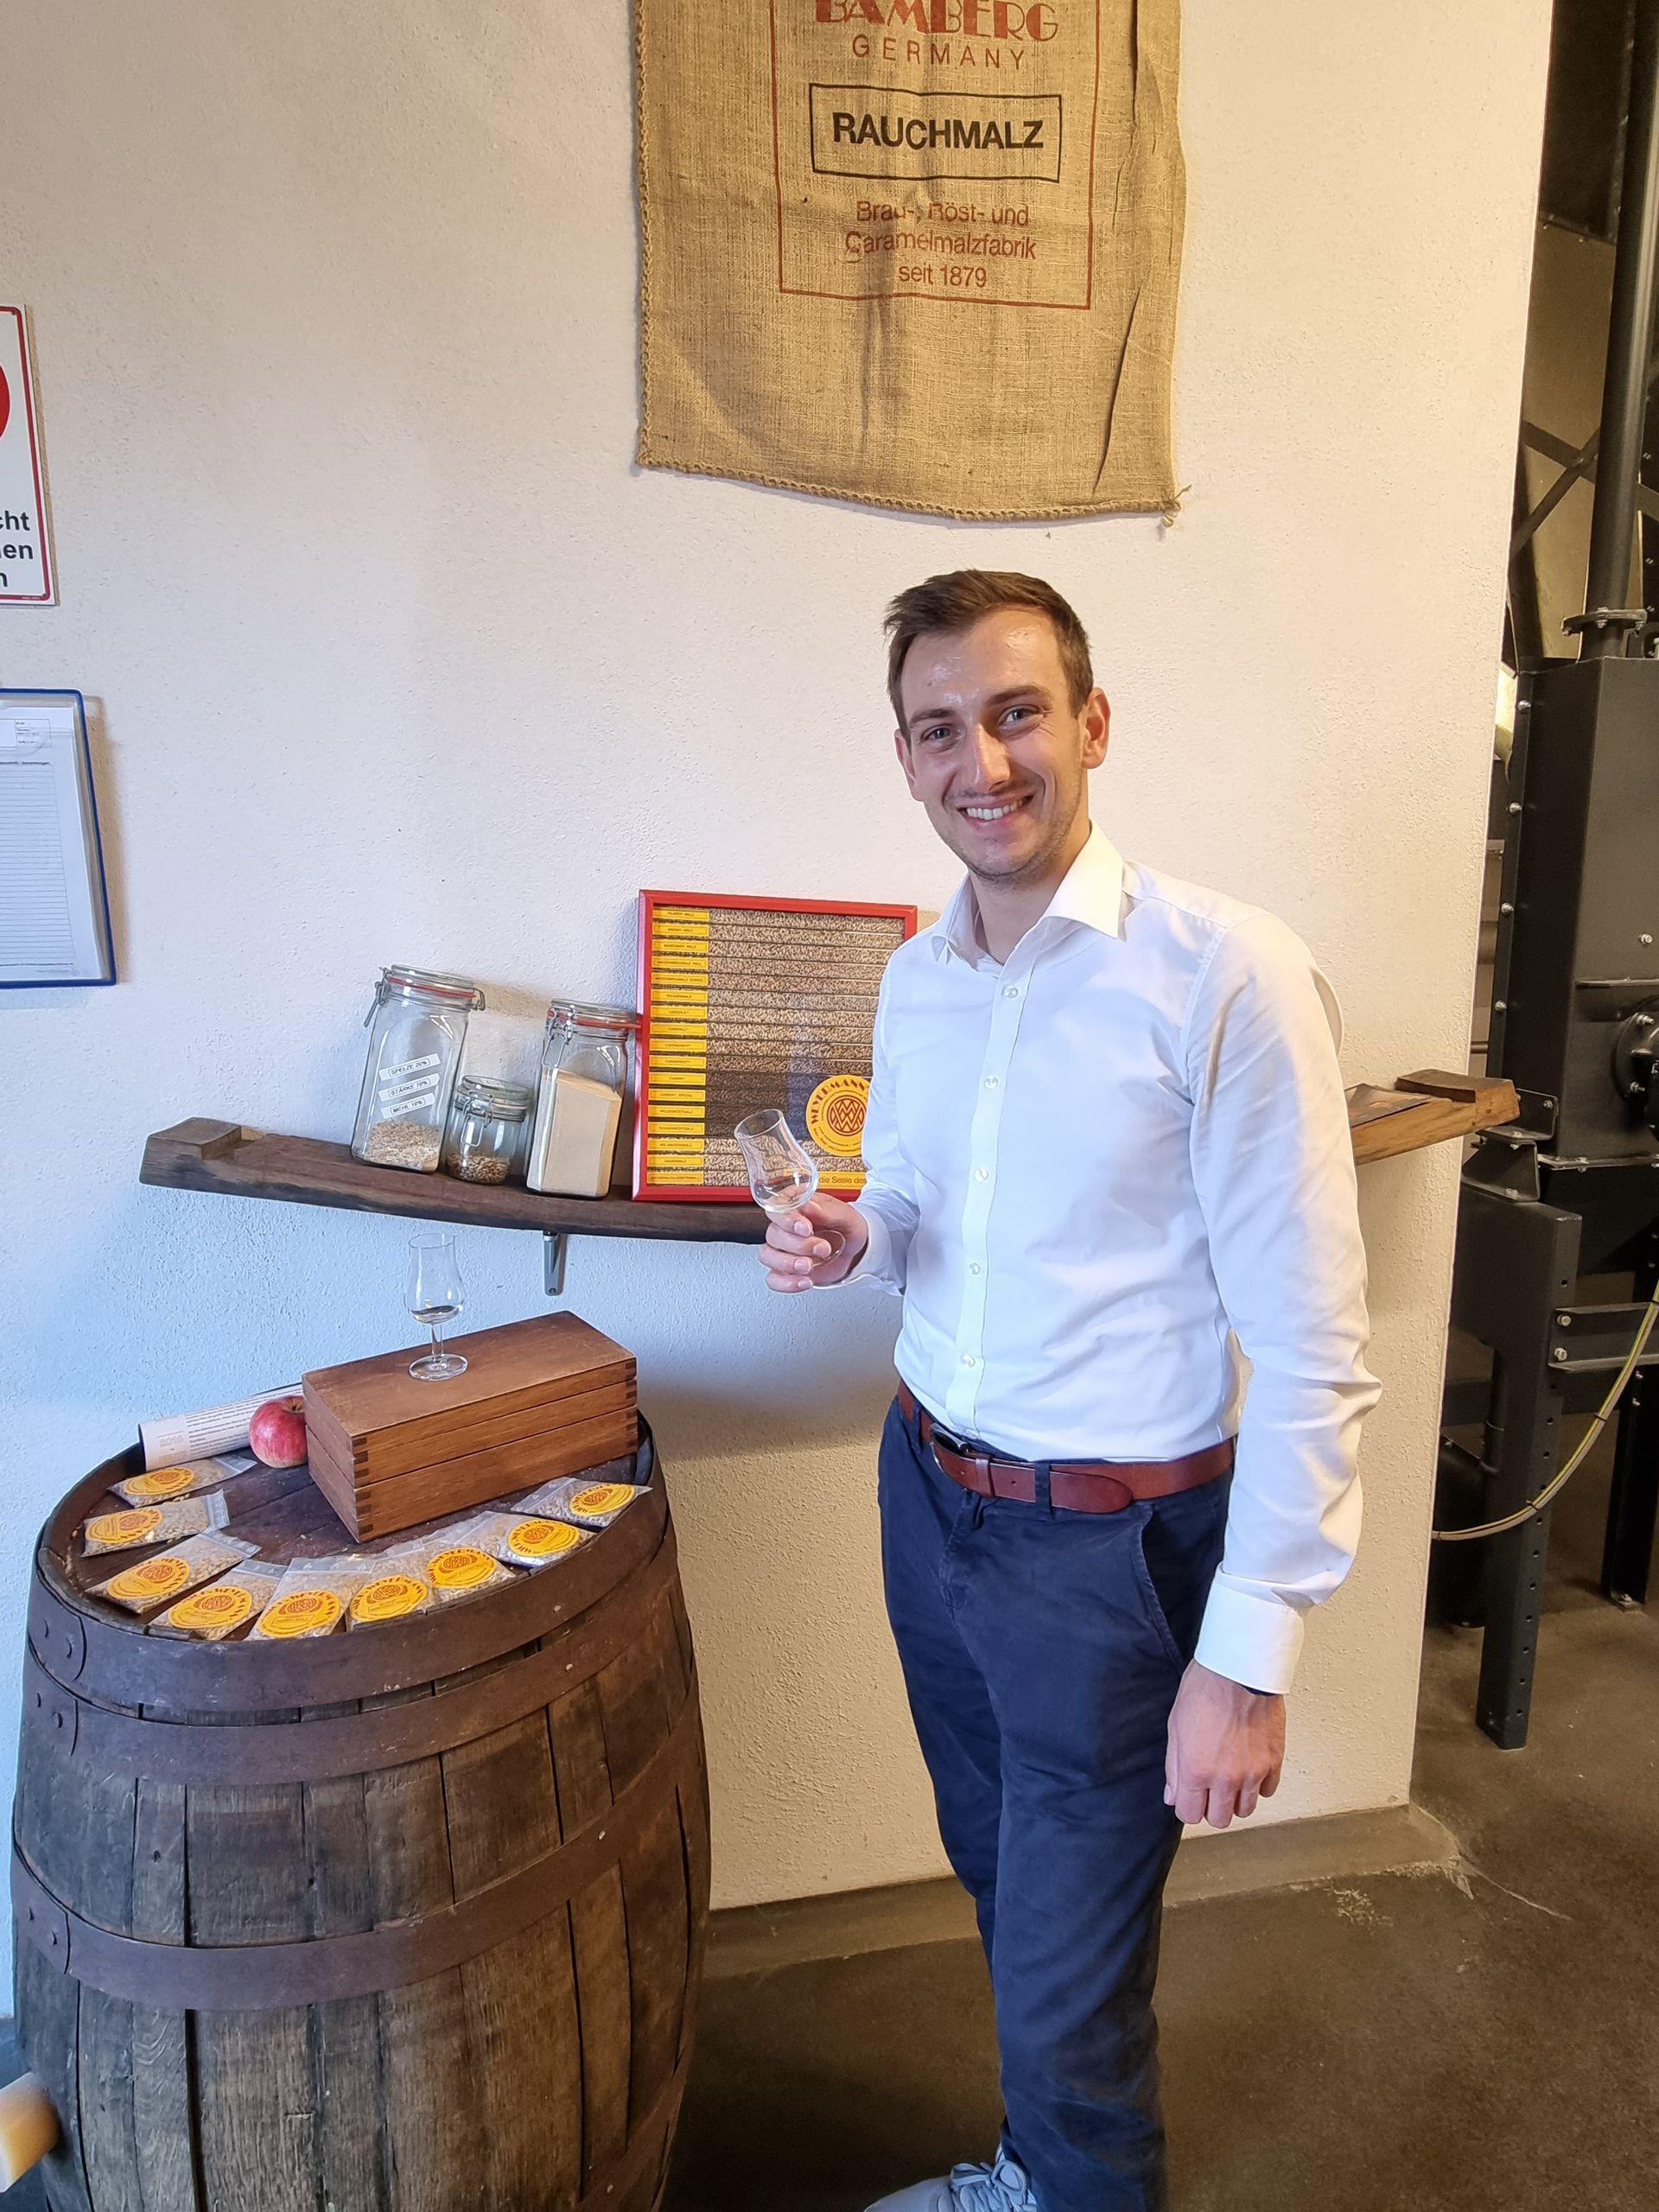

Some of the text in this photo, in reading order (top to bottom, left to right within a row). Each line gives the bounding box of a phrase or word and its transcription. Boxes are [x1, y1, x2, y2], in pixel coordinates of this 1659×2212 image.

[816, 0, 1058, 41] BAMBERG
[852, 33, 1025, 69] GERMANY
[832, 111, 1045, 150] RAUCHMALZ
[929, 200, 985, 222] Röst-
[991, 206, 1029, 227] und
[845, 230, 1037, 260] Caramelmalzfabrik
[899, 262, 987, 288] seit 1879
[0, 543, 34, 560] en
